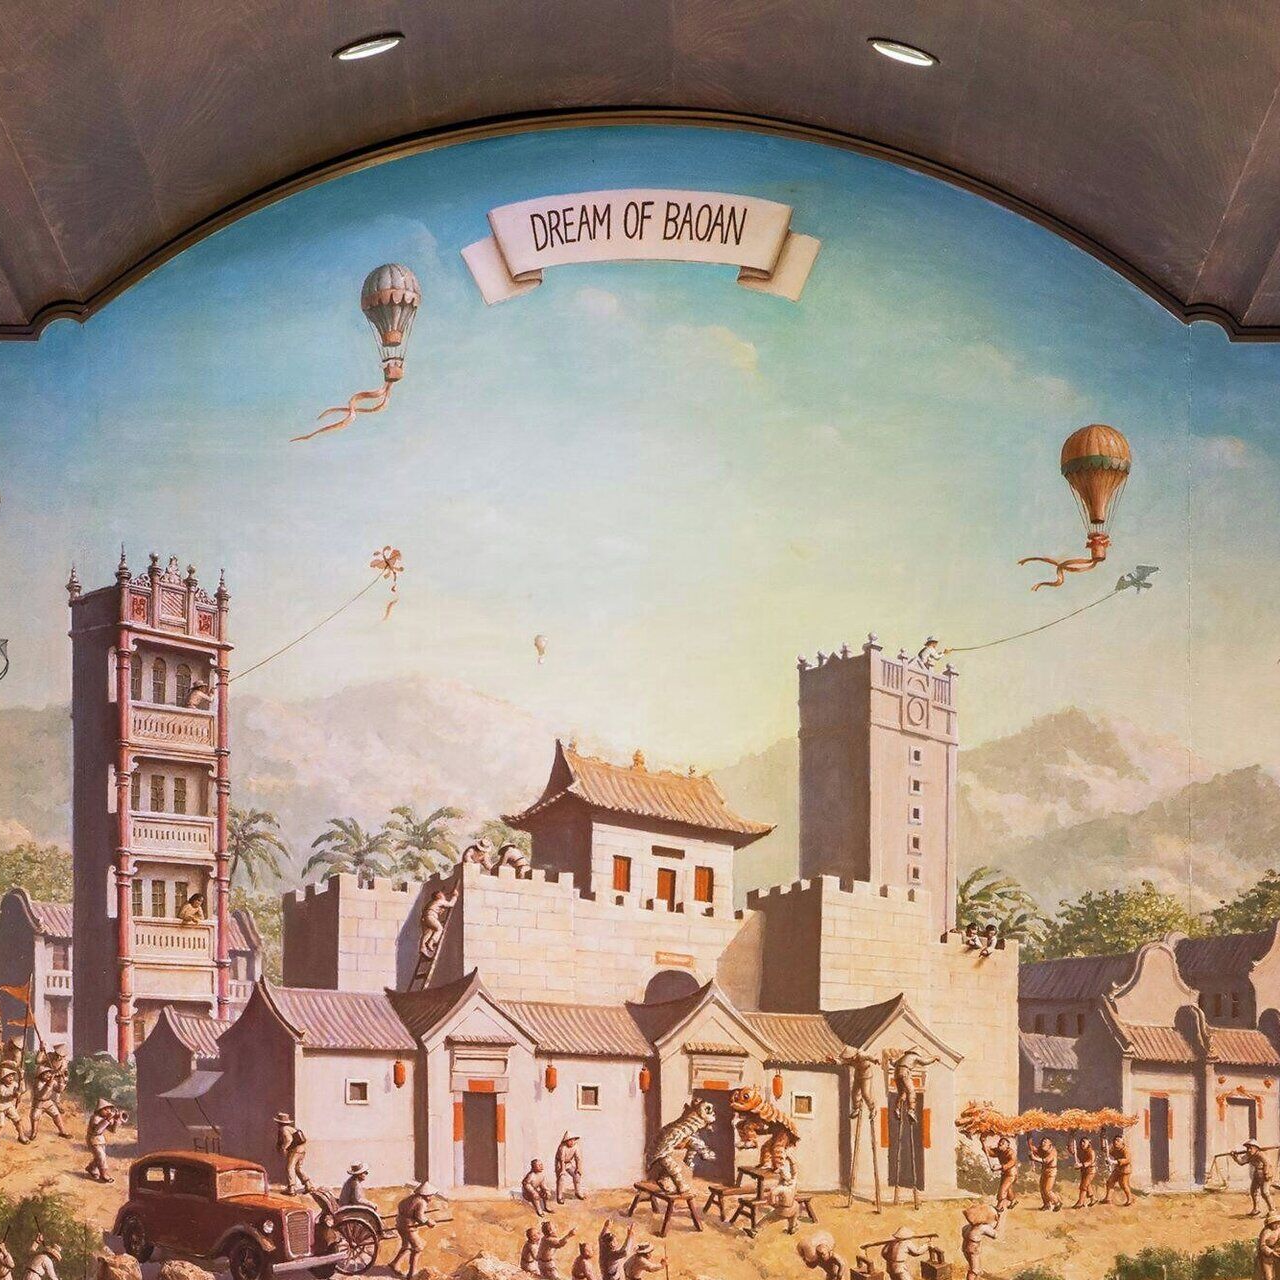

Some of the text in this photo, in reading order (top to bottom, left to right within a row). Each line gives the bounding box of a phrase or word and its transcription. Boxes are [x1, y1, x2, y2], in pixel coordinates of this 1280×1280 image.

[529, 200, 748, 252] DREAM OF BAOAN
